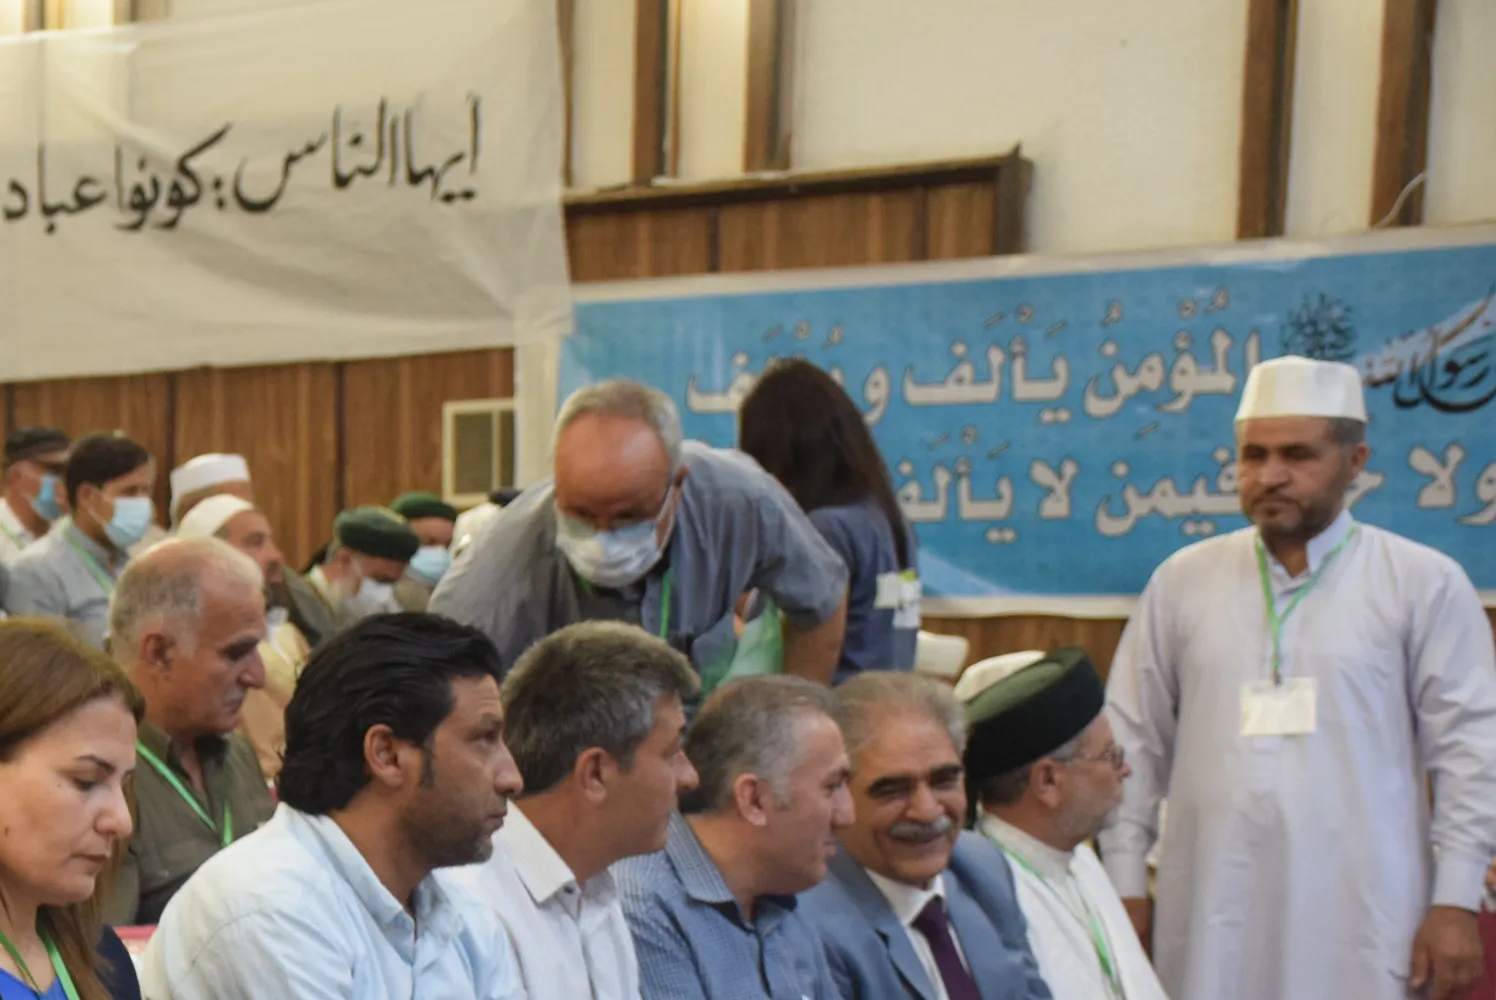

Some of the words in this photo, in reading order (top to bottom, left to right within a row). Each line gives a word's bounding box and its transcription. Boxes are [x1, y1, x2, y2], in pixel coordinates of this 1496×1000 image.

[3, 141, 106, 237] عباد
[113, 122, 232, 231] كونوا
[1027, 457, 1081, 521] لا
